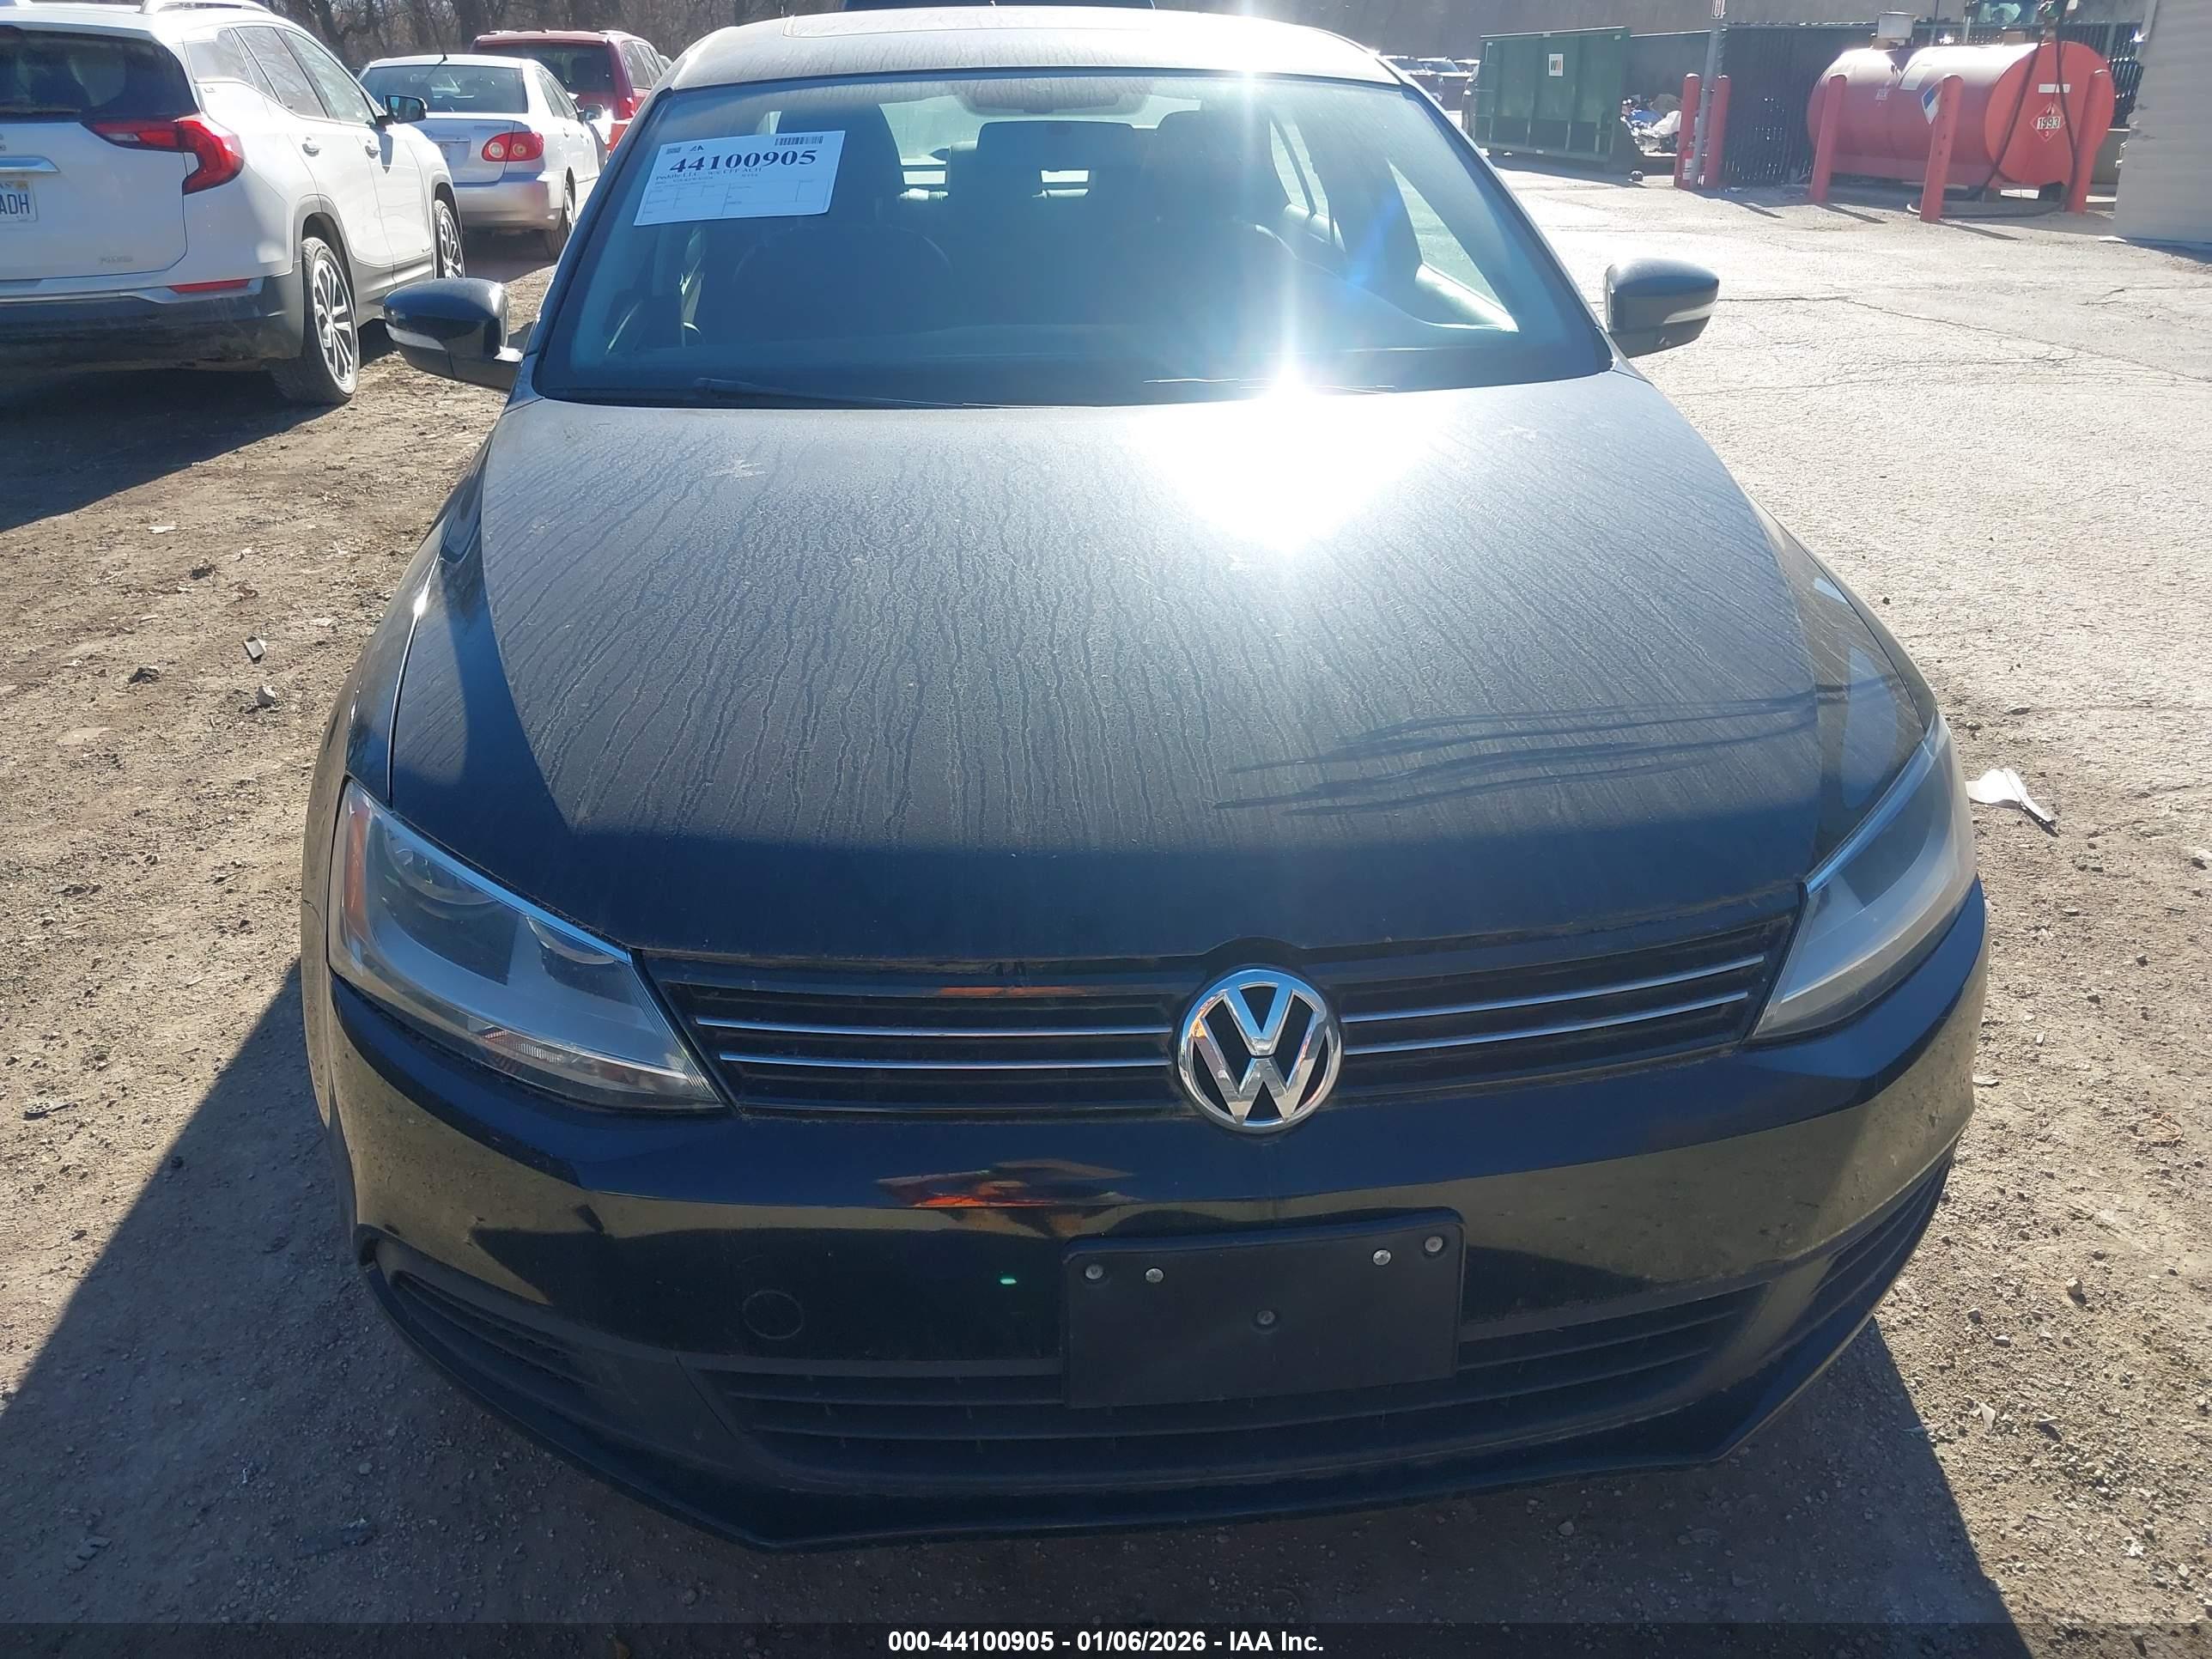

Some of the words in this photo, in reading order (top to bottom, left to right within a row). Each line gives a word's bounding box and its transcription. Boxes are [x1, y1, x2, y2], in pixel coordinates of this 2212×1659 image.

[2039, 117, 2059, 128] 1993
[670, 149, 817, 173] 44100905
[1182, 972, 1338, 1129] VW
